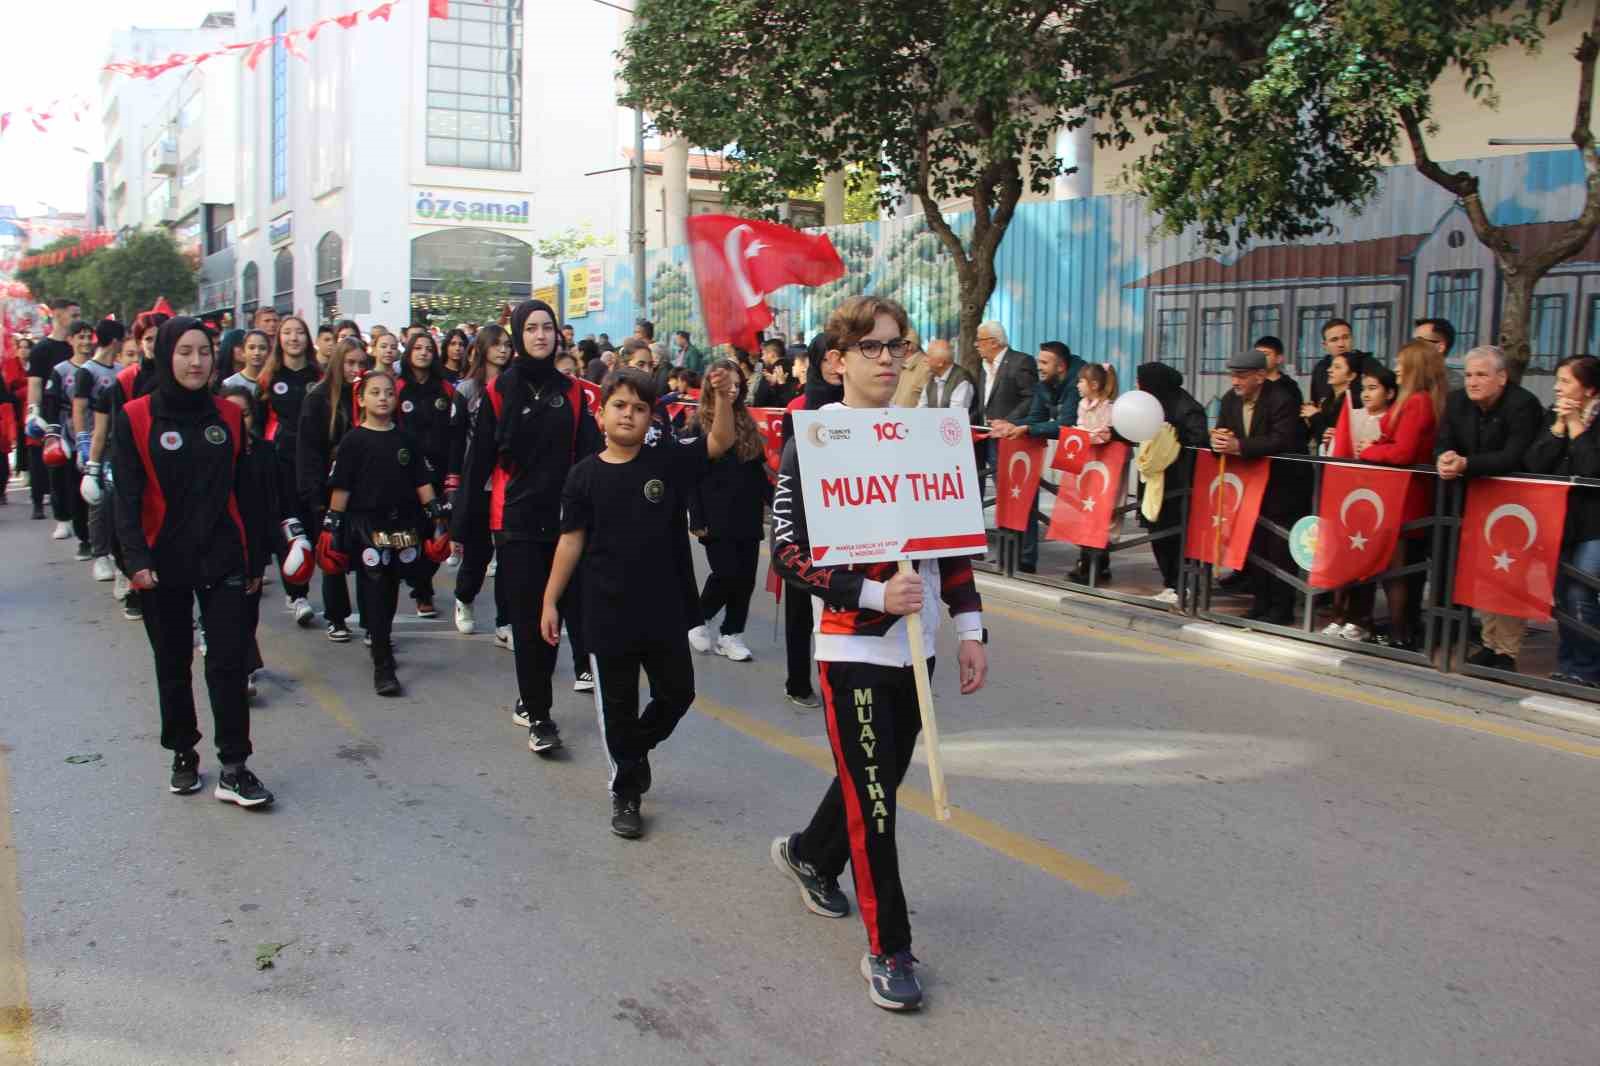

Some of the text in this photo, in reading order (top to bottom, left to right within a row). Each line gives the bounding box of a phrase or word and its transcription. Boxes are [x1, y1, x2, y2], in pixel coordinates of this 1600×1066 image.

[416, 192, 529, 223] özşanal
[773, 474, 794, 543] MUAY
[820, 474, 899, 508] MUAY
[853, 688, 888, 833] MUAY THAI
